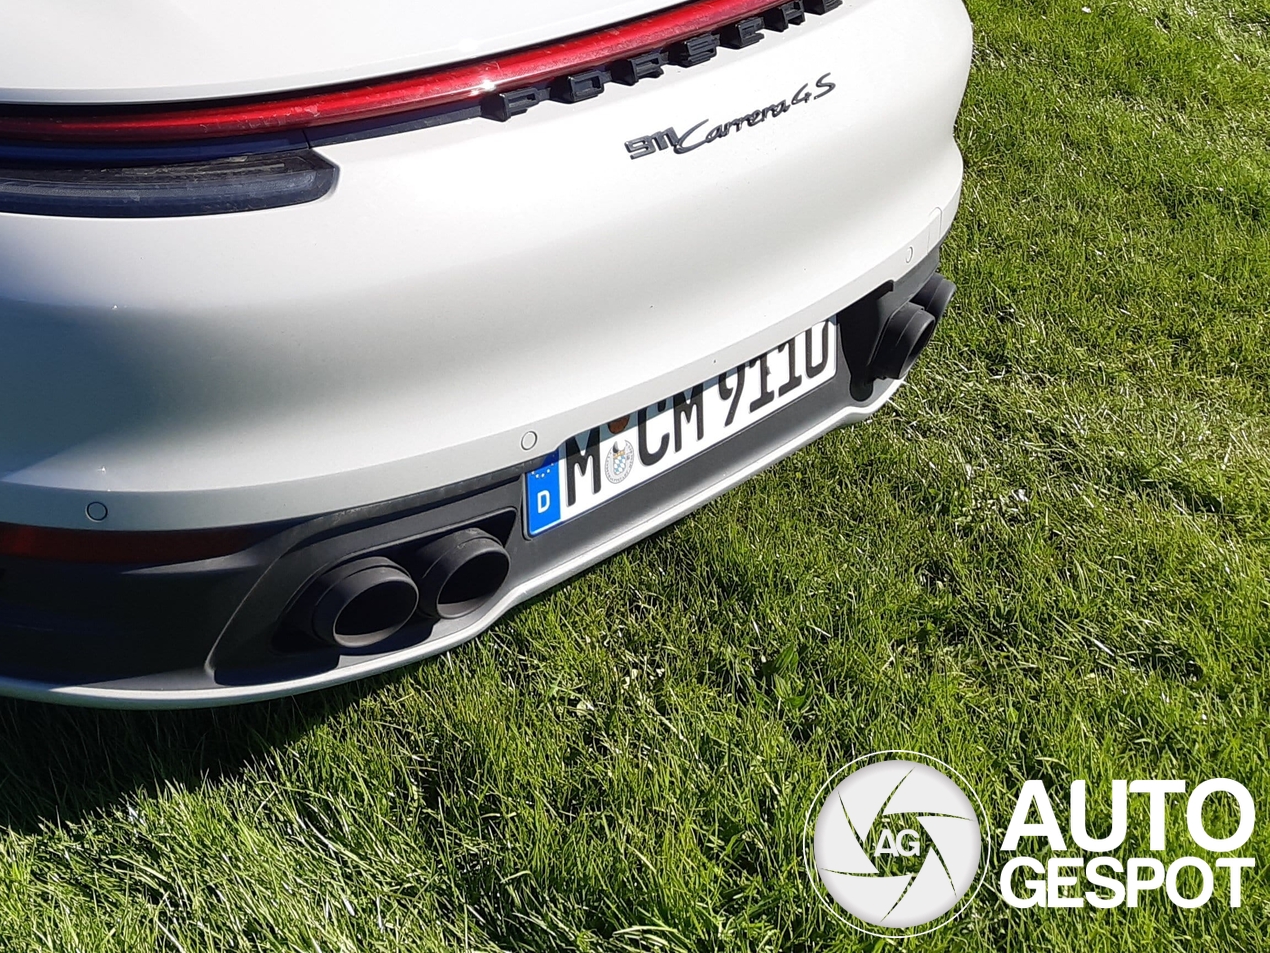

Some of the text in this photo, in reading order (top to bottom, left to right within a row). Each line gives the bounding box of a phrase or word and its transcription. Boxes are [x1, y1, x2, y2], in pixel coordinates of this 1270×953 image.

[624, 126, 679, 160] 911
[673, 99, 791, 154] Carrera
[565, 426, 602, 507] M
[637, 383, 705, 467] CM
[536, 489, 551, 514] D
